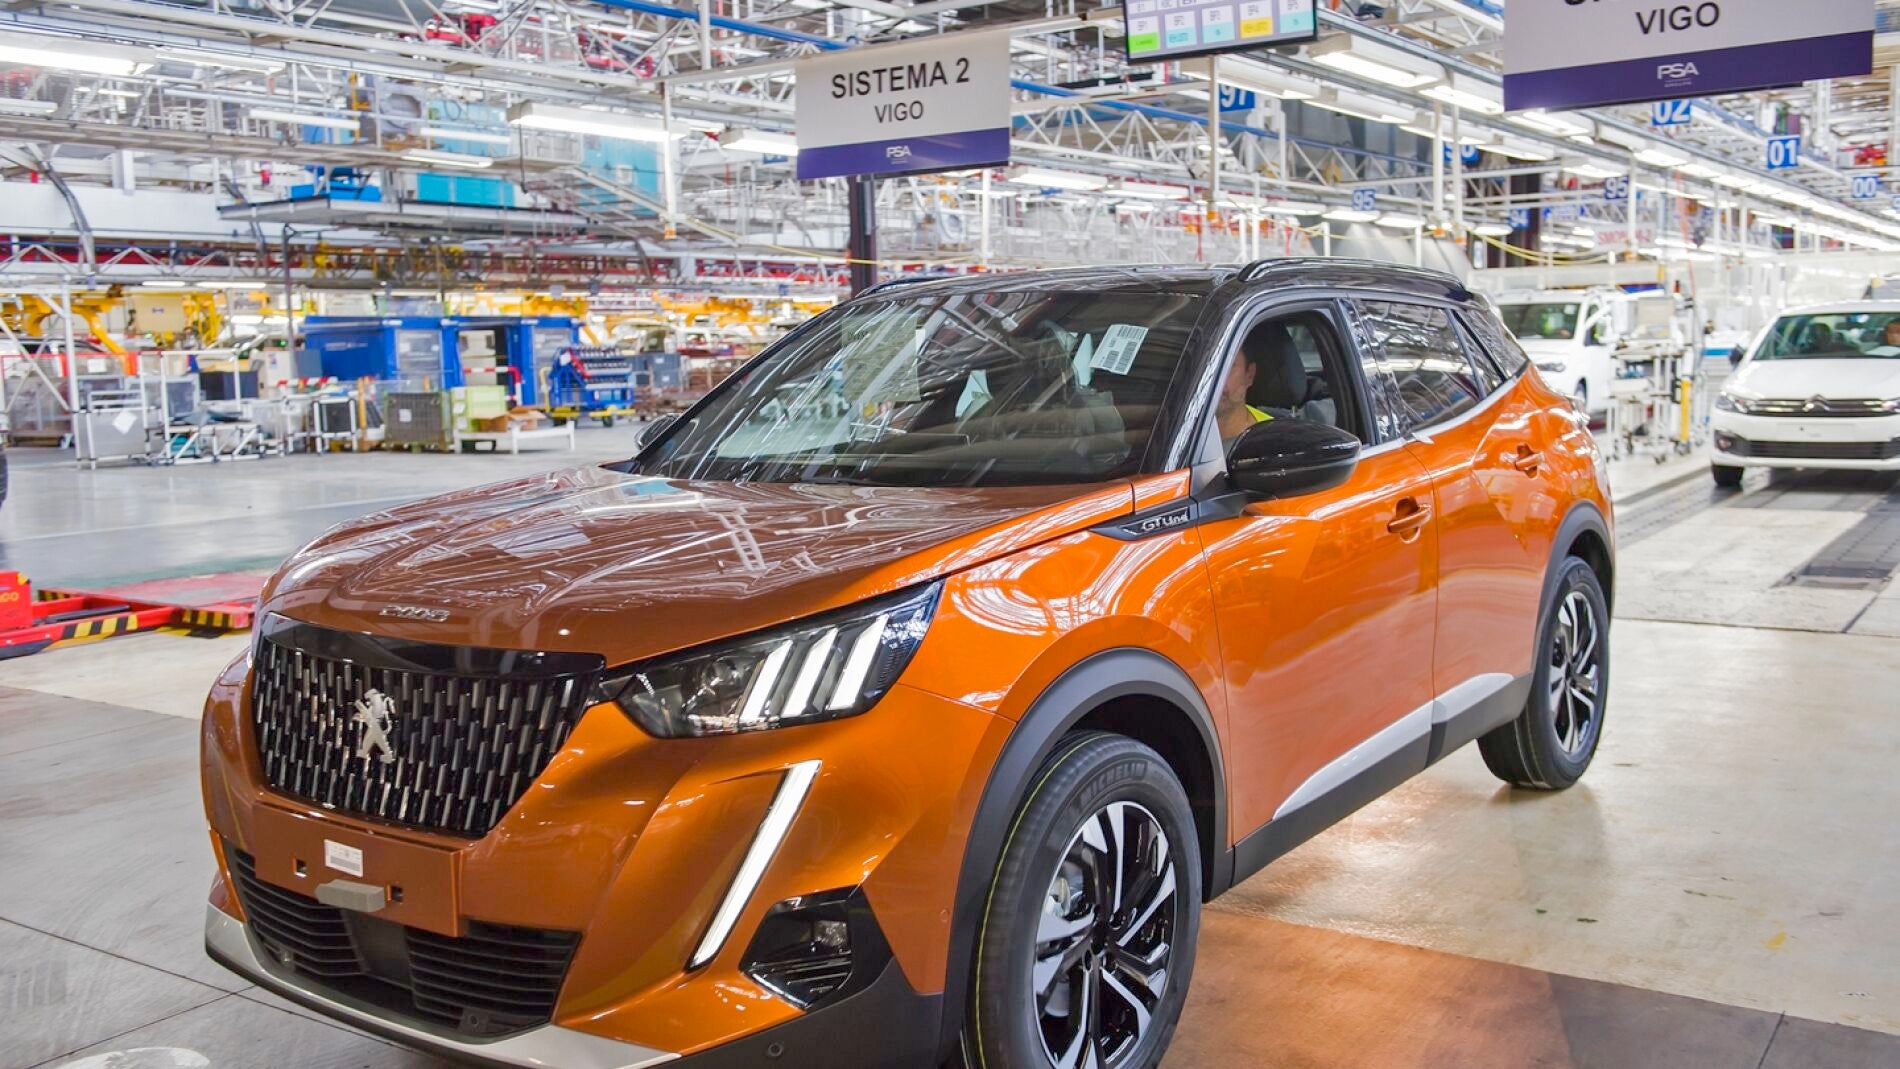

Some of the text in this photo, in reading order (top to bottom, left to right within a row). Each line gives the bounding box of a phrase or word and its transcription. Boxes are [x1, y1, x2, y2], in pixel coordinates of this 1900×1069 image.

[1635, 2, 1720, 35] VIGO
[831, 57, 970, 99] SISTEMA 2
[1657, 62, 1699, 80] PSA
[874, 100, 924, 123] VIGO
[1653, 98, 1692, 124] 02
[886, 145, 912, 158] PSA
[1769, 138, 1798, 167] 01
[1605, 176, 1630, 200] 95
[1852, 177, 1877, 198] 00
[1353, 190, 1376, 213] 95
[1081, 762, 1146, 805] MICHELIN
